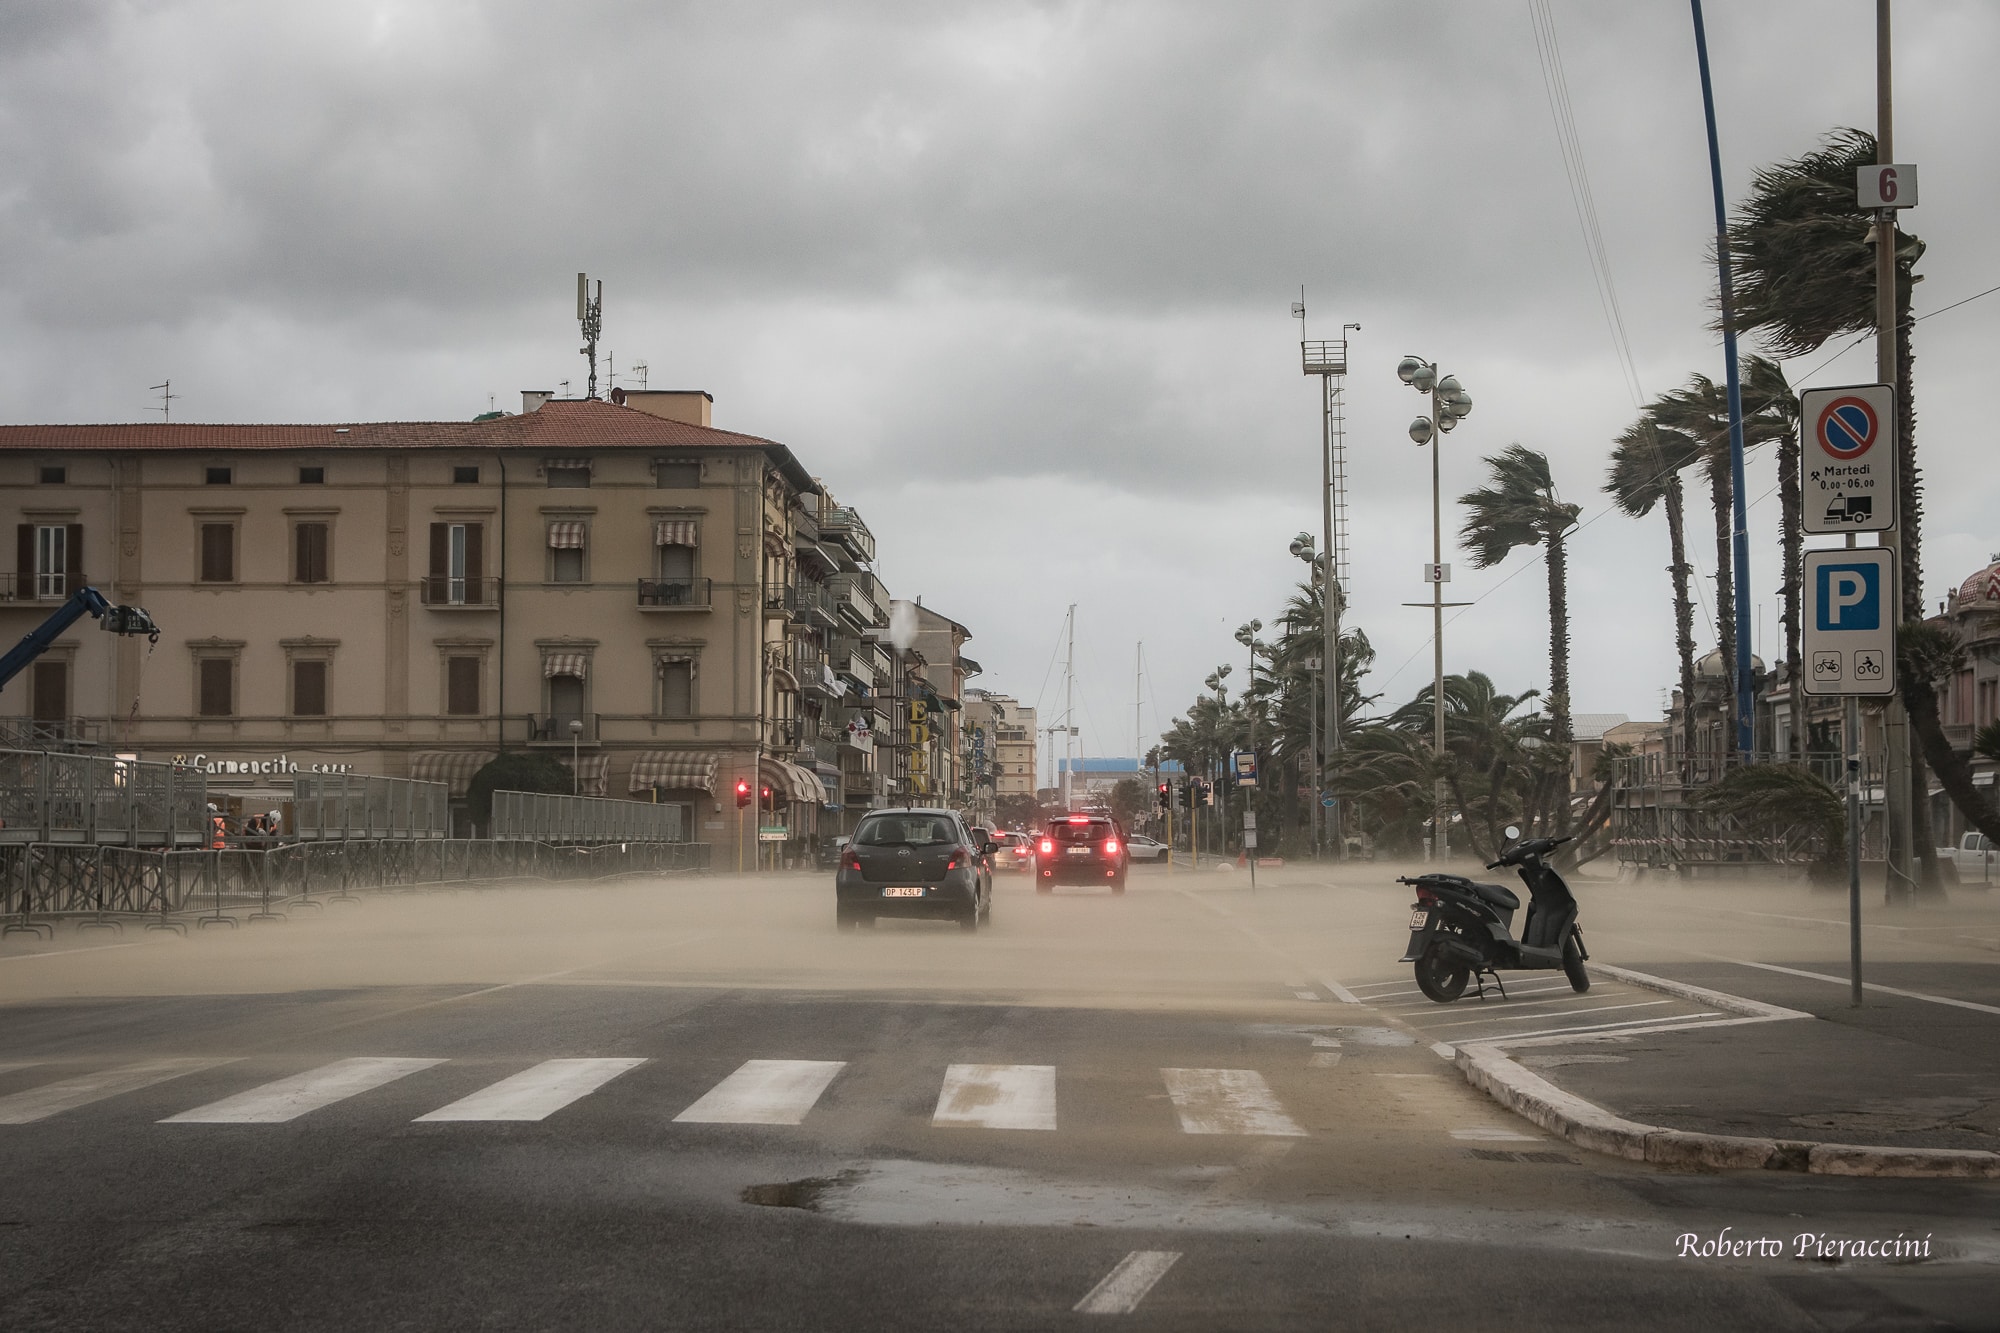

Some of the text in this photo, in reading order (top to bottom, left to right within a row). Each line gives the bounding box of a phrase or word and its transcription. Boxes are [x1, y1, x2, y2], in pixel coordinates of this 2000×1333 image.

[1879, 168, 1897, 202] 6
[1434, 565, 1442, 581] 5
[1829, 571, 1866, 624] P
[1310, 658, 1316, 669] 4
[909, 700, 929, 794] EDEN
[193, 754, 298, 775] Carmencita
